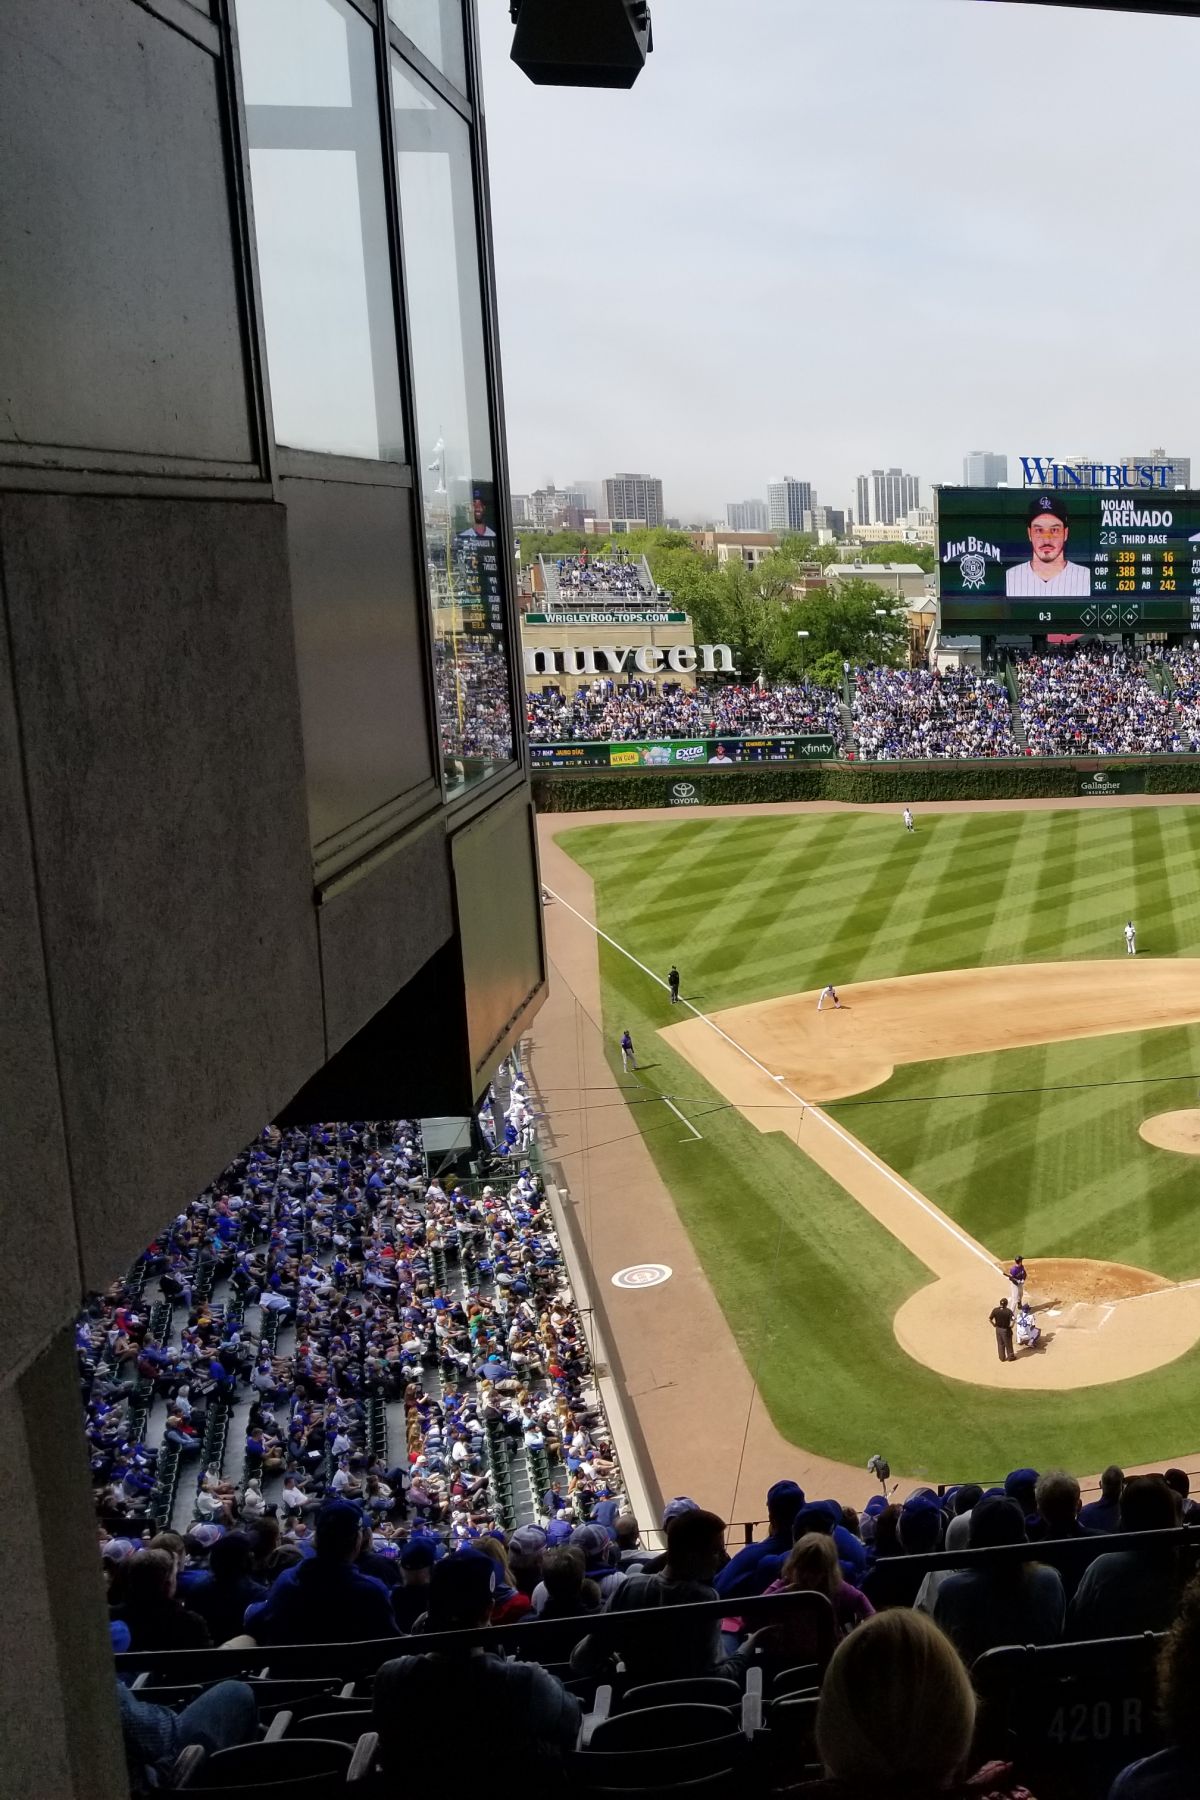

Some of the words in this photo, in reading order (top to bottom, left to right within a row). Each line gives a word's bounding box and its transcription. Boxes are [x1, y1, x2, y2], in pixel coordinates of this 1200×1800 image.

[1020, 457, 1173, 487] WINTRUST
[1101, 500, 1134, 510] NOLAN
[1102, 510, 1172, 526] ARENADO
[1100, 532, 1116, 544] 28
[1122, 535, 1146, 544] THIRD
[1148, 535, 1168, 544] BASE
[944, 541, 966, 563] JIM
[968, 536, 1001, 563] BEAM
[1095, 554, 1108, 562] AVG
[1116, 552, 1135, 562] .339
[1142, 554, 1152, 562] HR
[1163, 552, 1174, 562] 16
[1095, 567, 1108, 576] OBP
[1116, 566, 1135, 576] .388
[1142, 567, 1152, 575] RBI
[1162, 566, 1174, 576] 54
[1095, 582, 1106, 590] SLG
[1116, 580, 1135, 590] .620
[1142, 581, 1150, 589] AB
[1160, 580, 1176, 590] 242
[545, 614, 668, 622] WRIGLEYROOFTOPS.COM
[1039, 612, 1051, 620] 0-3
[525, 643, 736, 675] nuveen
[676, 746, 704, 760] Extra
[802, 744, 832, 756] xfinity
[1081, 782, 1120, 790] Gallagher
[1048, 1700, 1112, 1744] 420
[1122, 1698, 1142, 1736] R
